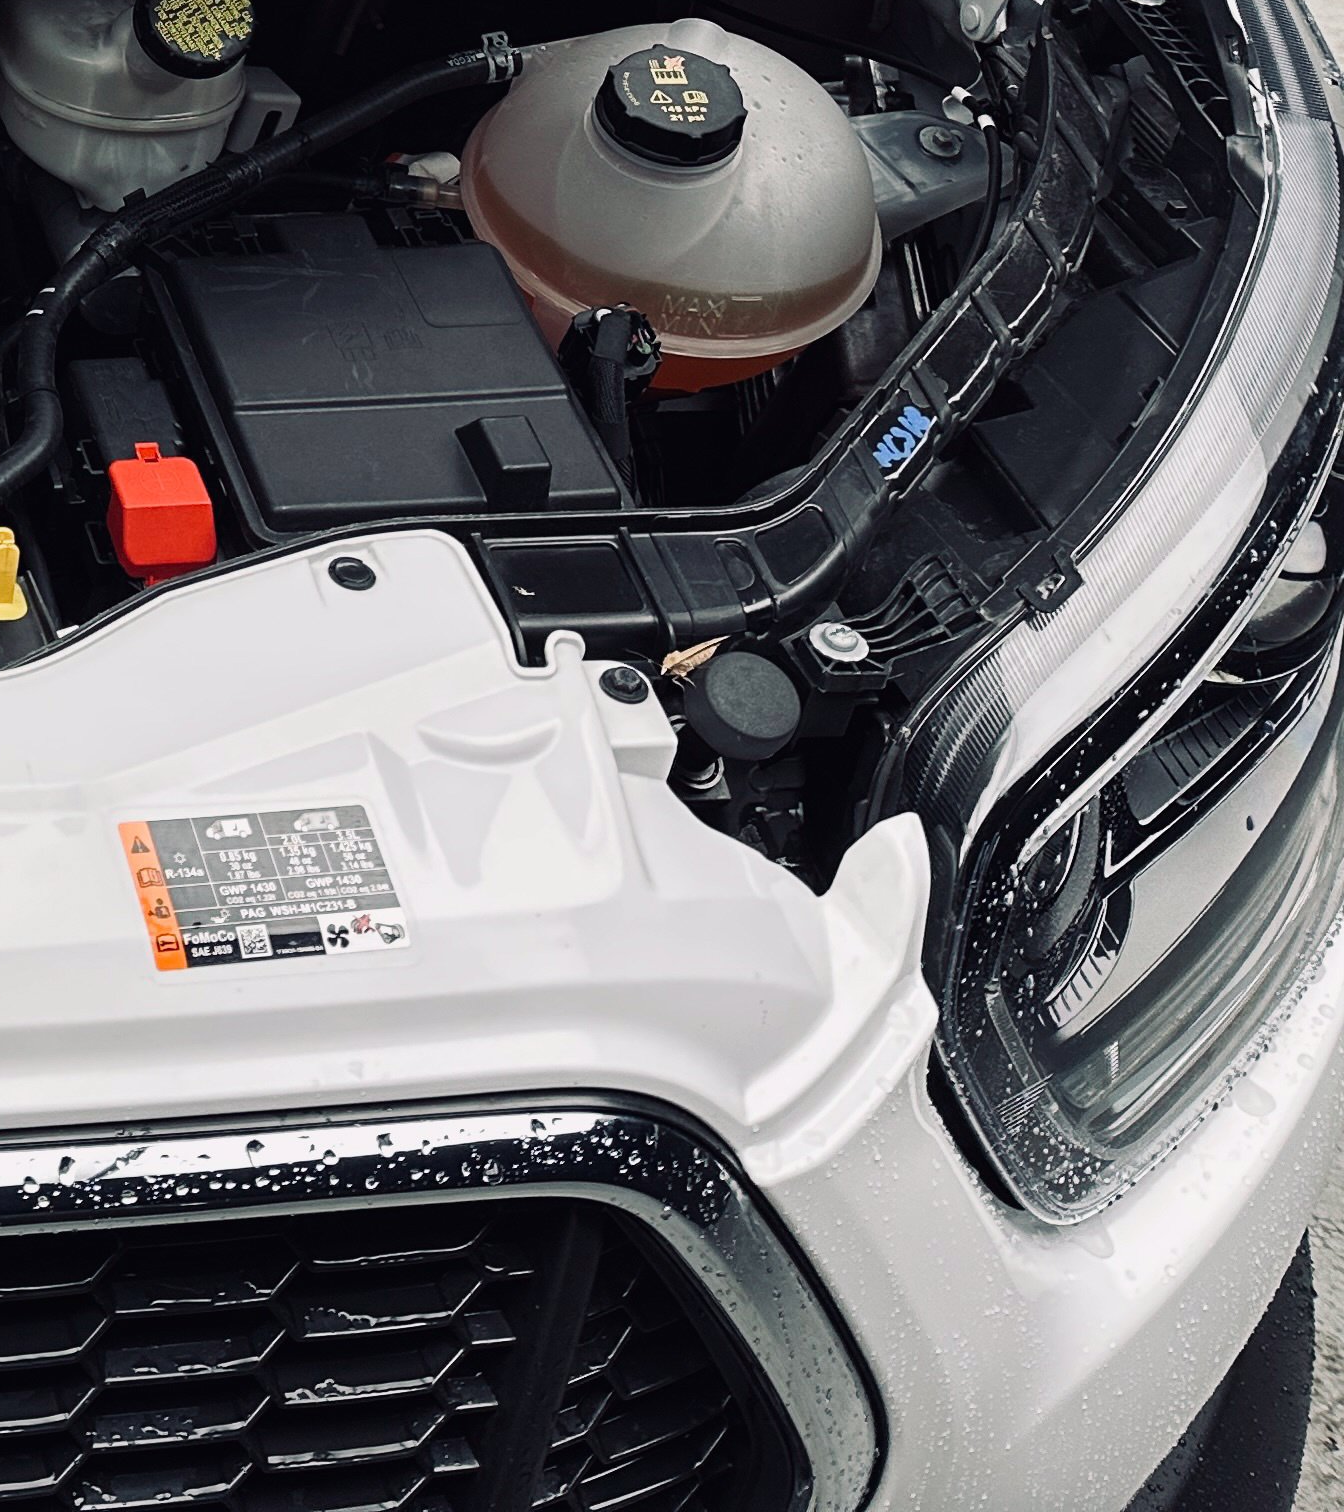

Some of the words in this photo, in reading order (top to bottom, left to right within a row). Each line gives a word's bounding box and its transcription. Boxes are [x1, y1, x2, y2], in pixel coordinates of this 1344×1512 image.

[685, 105, 707, 113] kPa
[687, 114, 705, 122] psi
[661, 294, 726, 318] MAX
[660, 313, 724, 336] MIN
[302, 846, 316, 857] kg
[359, 841, 372, 852] kg
[243, 852, 257, 862] kg
[165, 868, 204, 879] R-134a
[306, 877, 333, 888] GWP
[336, 875, 362, 885] 1430
[219, 885, 248, 896] GWP
[251, 882, 276, 893] 1430
[240, 908, 265, 919] PAG
[183, 930, 235, 945] FoMoCo
[191, 947, 211, 957] SAE
